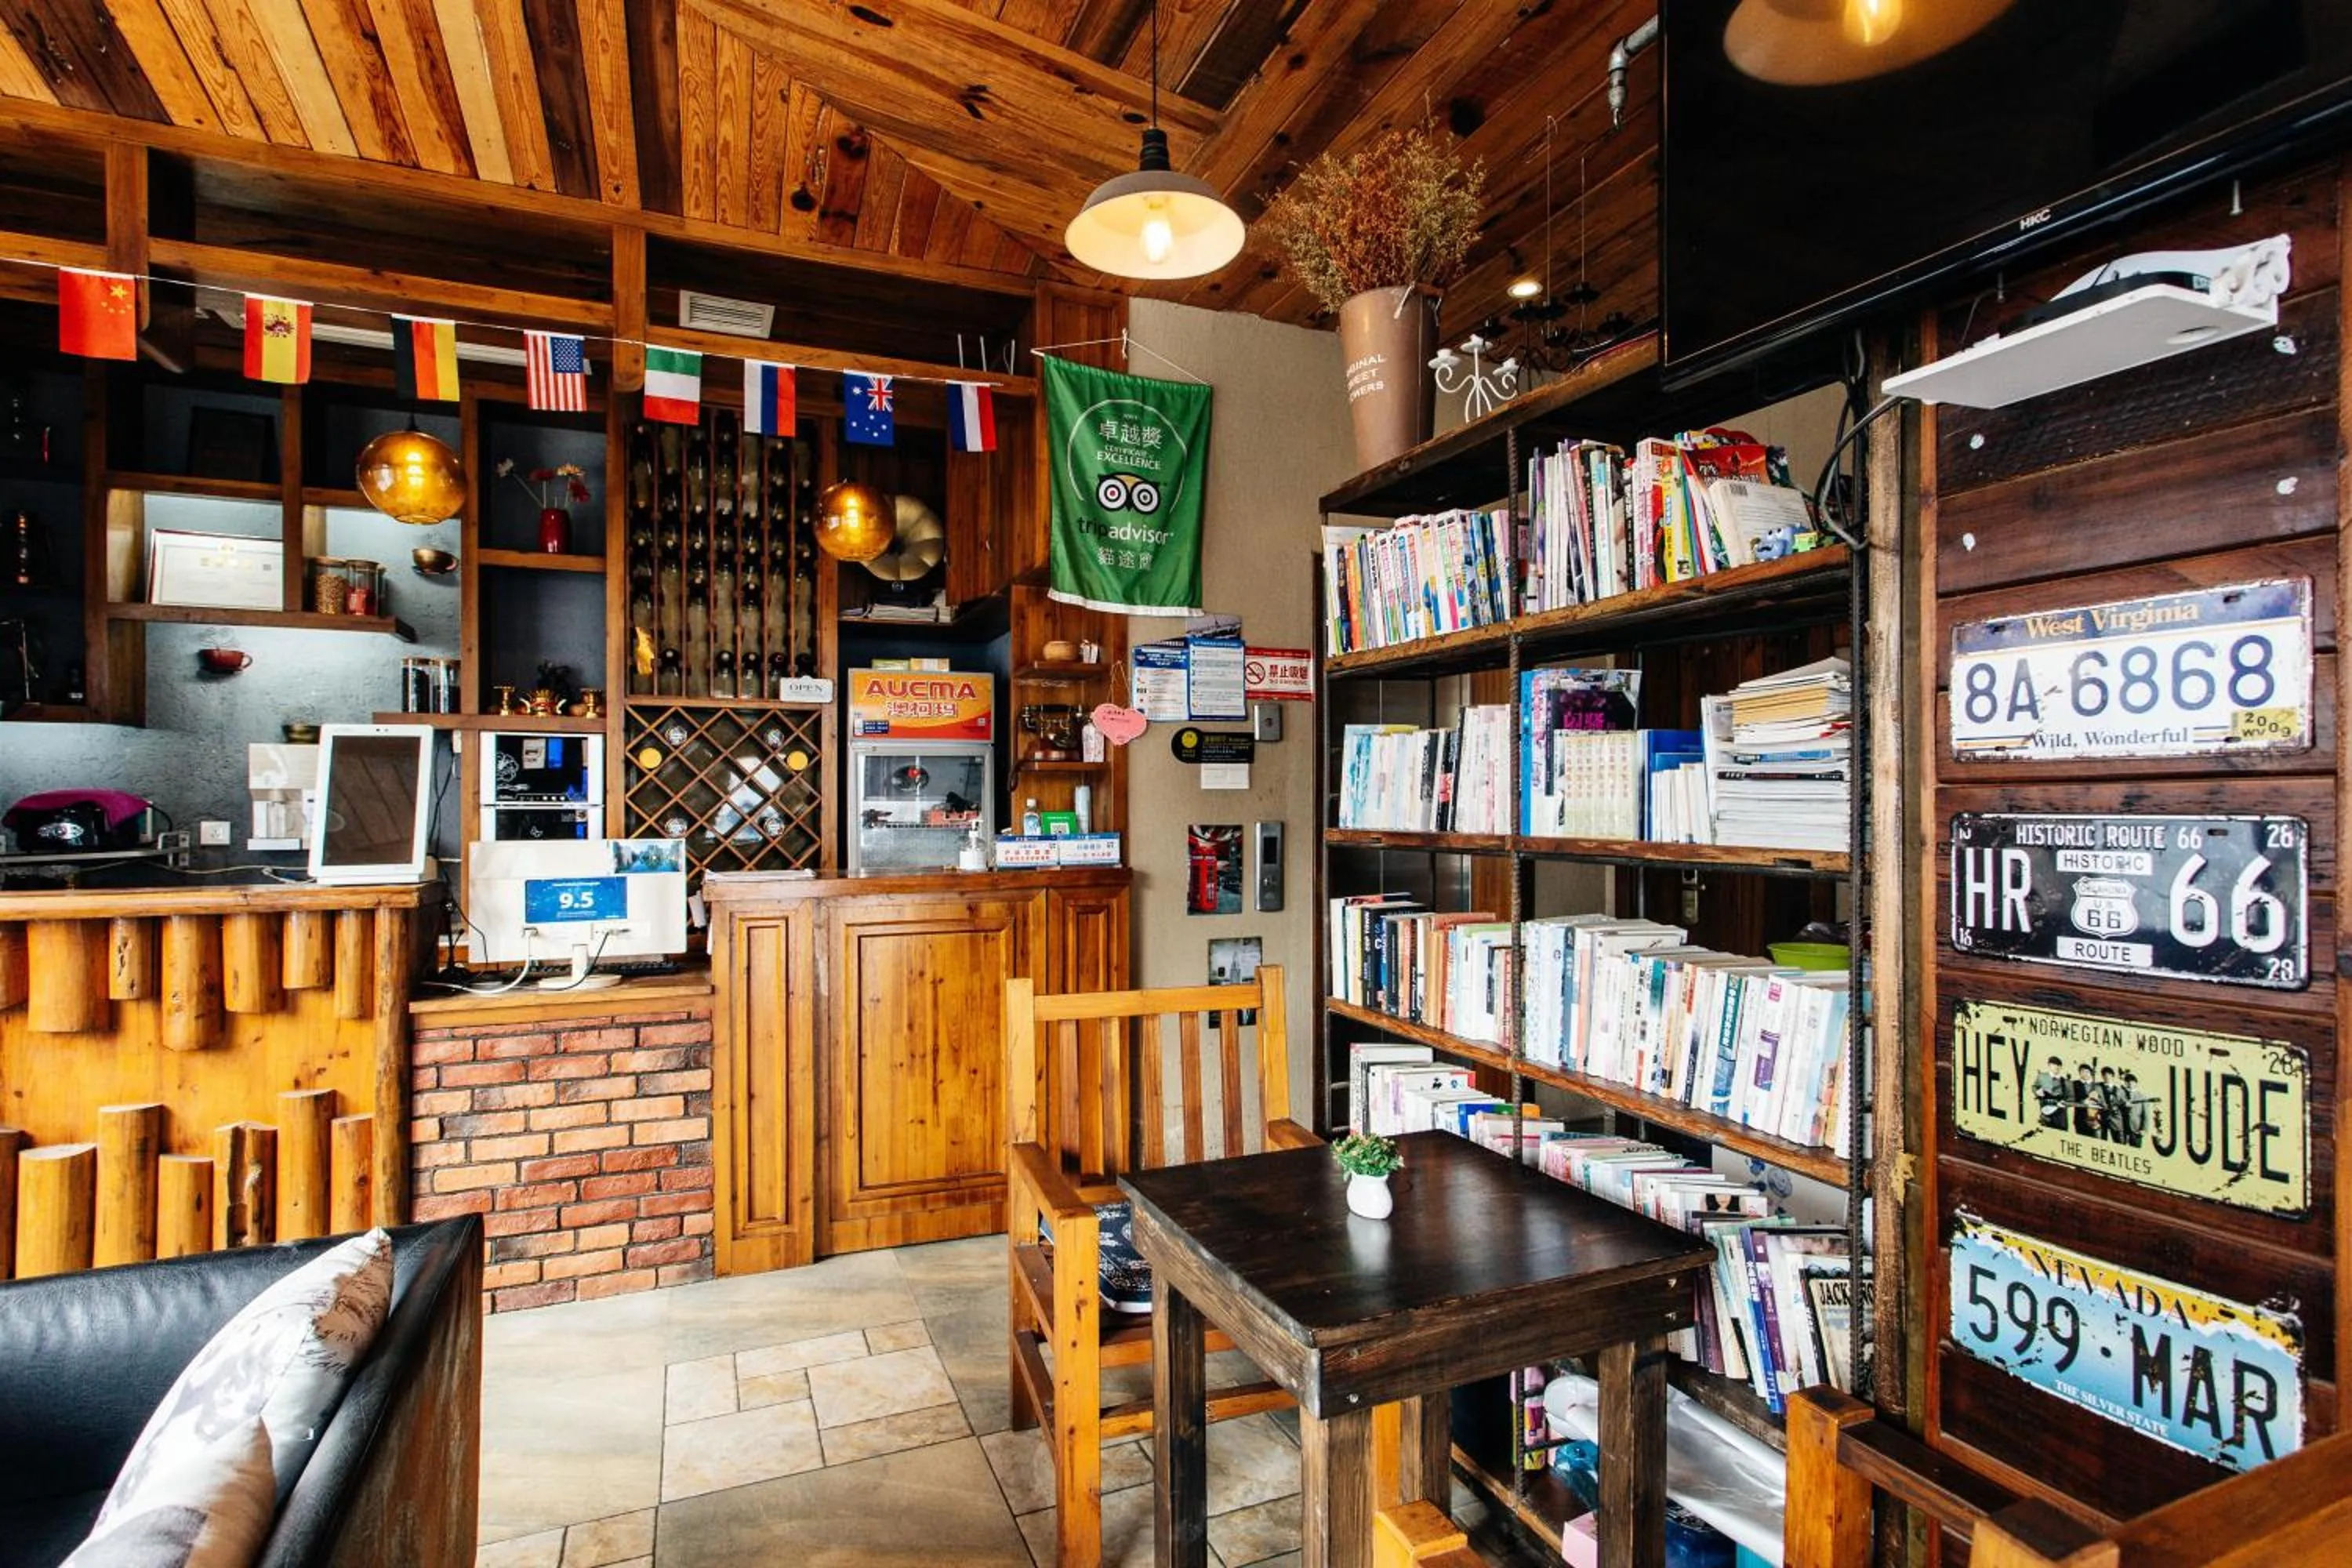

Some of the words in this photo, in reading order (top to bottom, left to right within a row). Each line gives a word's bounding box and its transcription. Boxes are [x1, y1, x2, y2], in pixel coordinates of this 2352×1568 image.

[2020, 209, 2052, 231] HKC
[1097, 451, 1161, 470] EXCELLENCE
[1077, 517, 1169, 545] tripadvisor
[2025, 615, 2085, 638] West
[2089, 599, 2201, 633] Virginia
[866, 679, 977, 699] AUCMA
[2084, 728, 2190, 748] Wonderful
[2016, 824, 2096, 848] HISTORIC
[2107, 825, 2165, 849] ROUTE
[2177, 828, 2202, 850] 66
[2064, 853, 2144, 871] HISTORIC
[559, 891, 594, 909] 9.5
[1965, 848, 2032, 933] HR
[2169, 854, 2286, 953] 66
[2088, 909, 2122, 929] 66
[2074, 943, 2132, 963] ROUTE
[2028, 1017, 2122, 1047] NORWEGIAN
[2136, 1034, 2184, 1057] WOOD
[2269, 1051, 2292, 1075] 28
[1962, 1030, 2031, 1124] HEY
[2151, 1065, 2290, 1184] JUDE
[2060, 1139, 2083, 1159] THE
[2091, 1146, 2151, 1175] BEATLES
[2031, 1249, 2191, 1330] NEVADA
[2055, 1379, 2080, 1399] THE
[2080, 1391, 2125, 1418] SILVER
[2125, 1410, 2170, 1437] STATE
